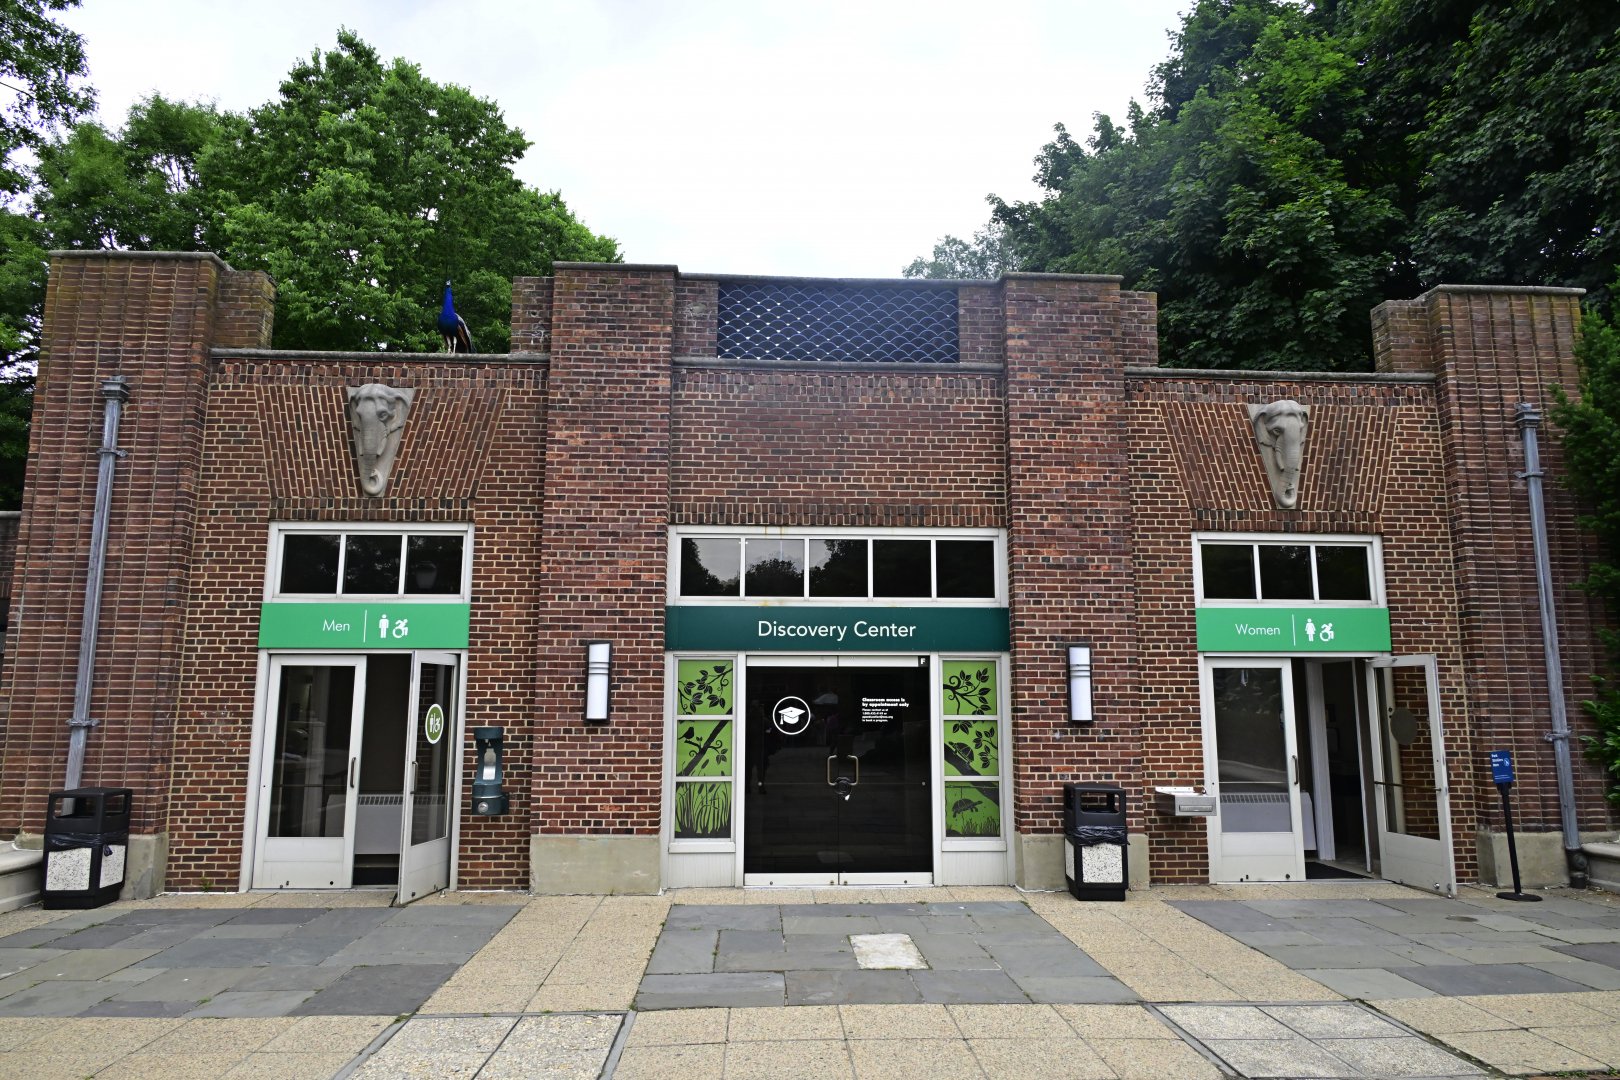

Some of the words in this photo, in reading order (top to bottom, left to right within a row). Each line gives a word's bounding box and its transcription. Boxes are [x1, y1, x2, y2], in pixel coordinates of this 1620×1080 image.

[322, 618, 350, 632] Men
[758, 620, 847, 642] Discovery
[853, 620, 917, 637] Center
[1234, 623, 1281, 636] Women
[920, 657, 926, 665] F
